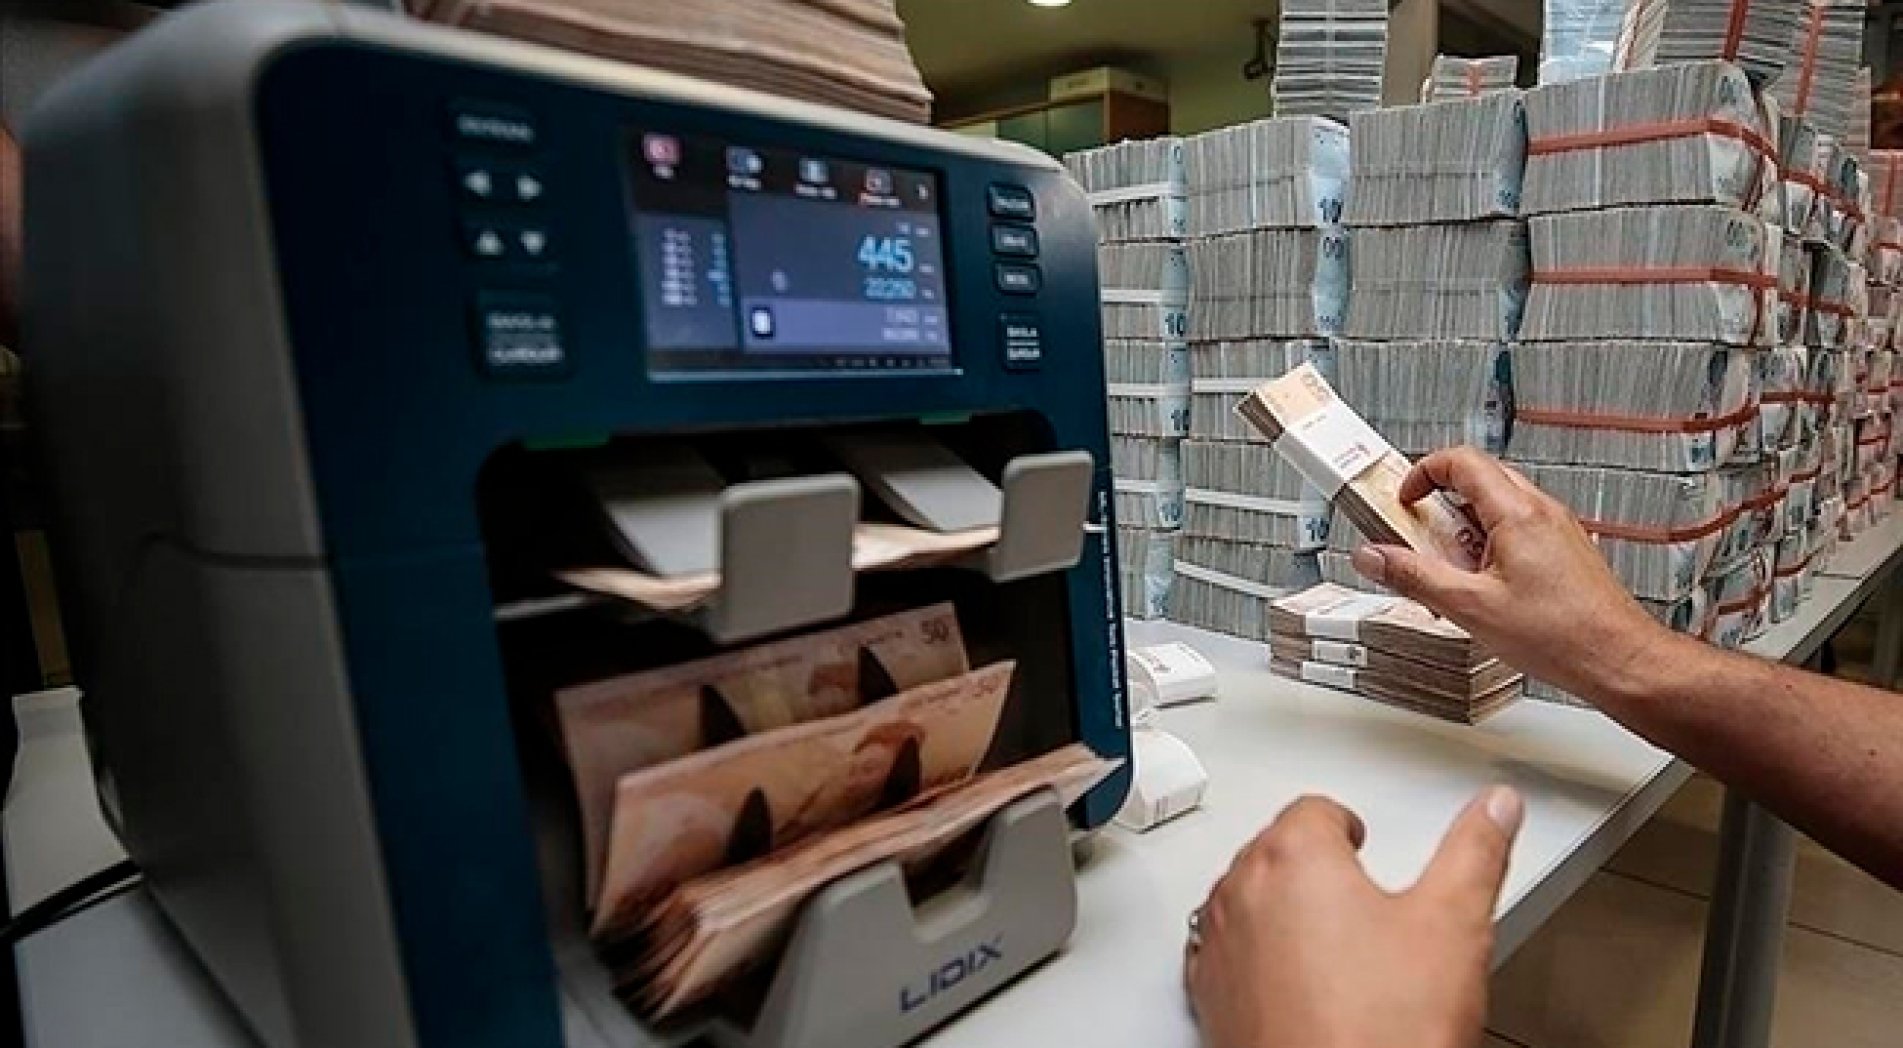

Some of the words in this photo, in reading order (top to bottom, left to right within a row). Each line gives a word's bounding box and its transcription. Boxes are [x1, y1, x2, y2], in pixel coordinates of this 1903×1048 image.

[858, 234, 914, 273] 445
[919, 614, 950, 645] 50
[900, 932, 1004, 1012] LIDIX
